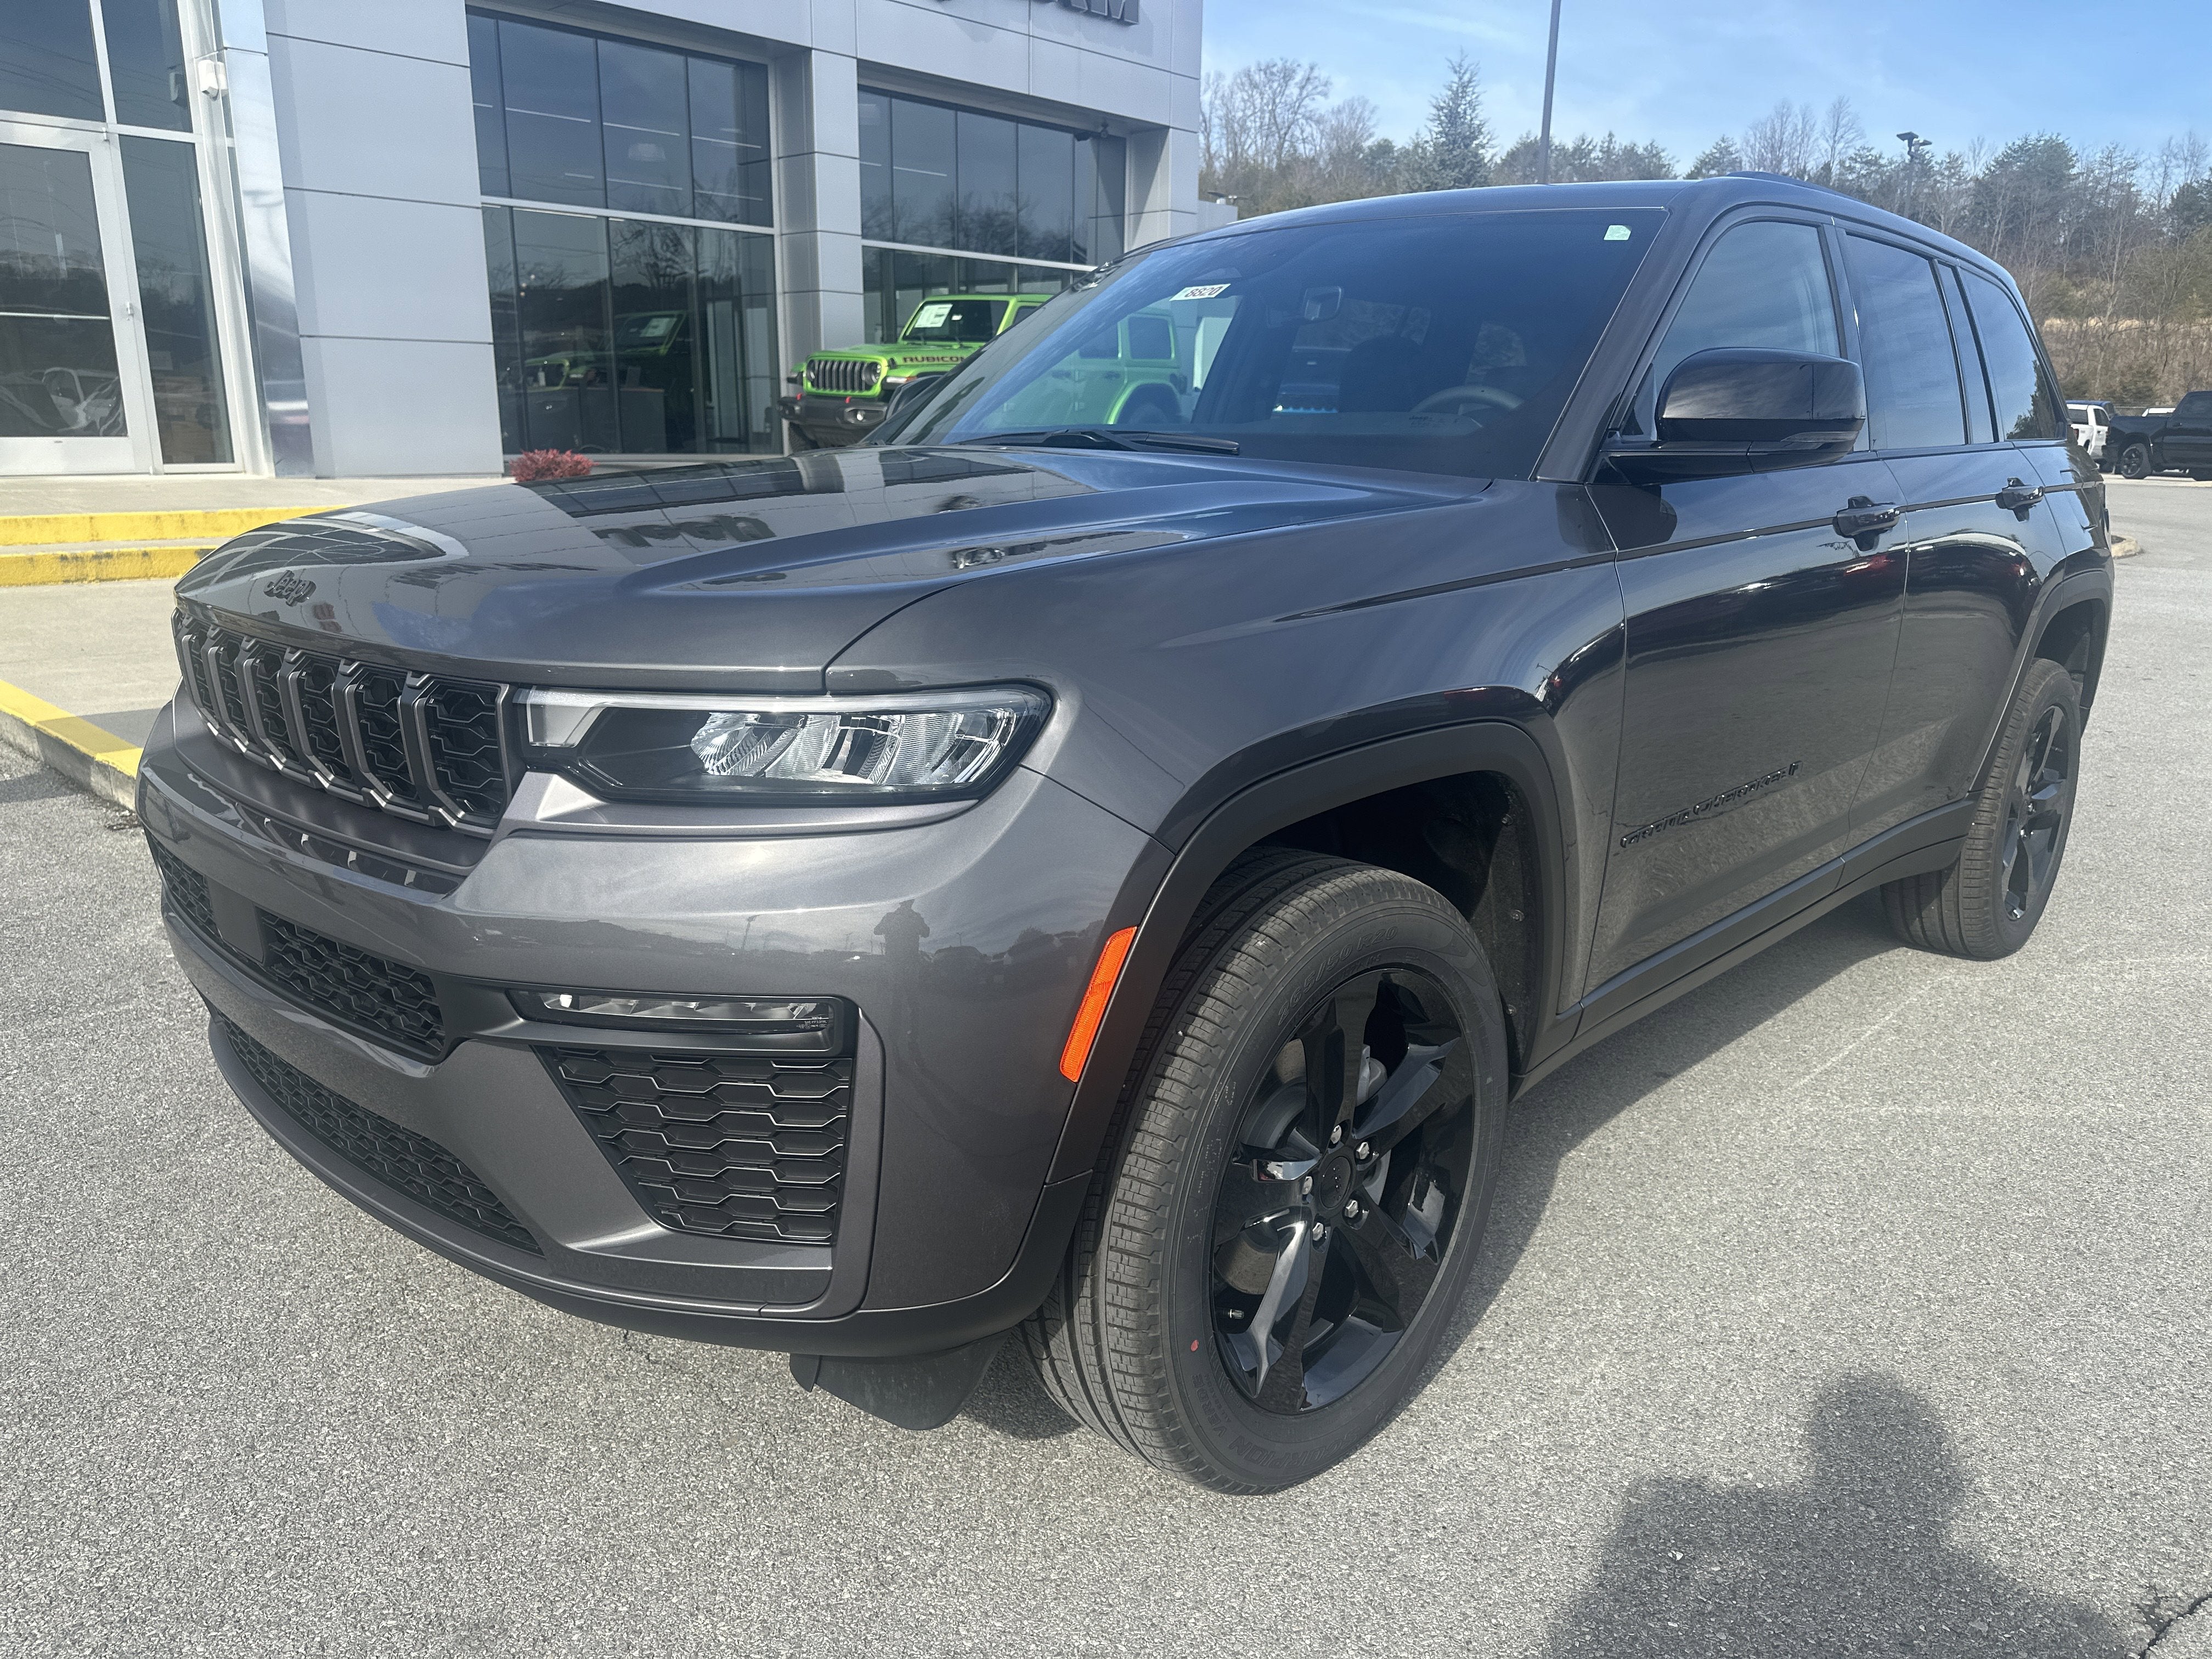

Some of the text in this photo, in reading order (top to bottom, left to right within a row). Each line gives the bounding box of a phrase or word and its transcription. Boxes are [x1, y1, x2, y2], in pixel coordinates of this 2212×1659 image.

[1184, 286, 1223, 297] 8820
[263, 570, 316, 607] Jeep
[1191, 1373, 1227, 1438] VERDE
